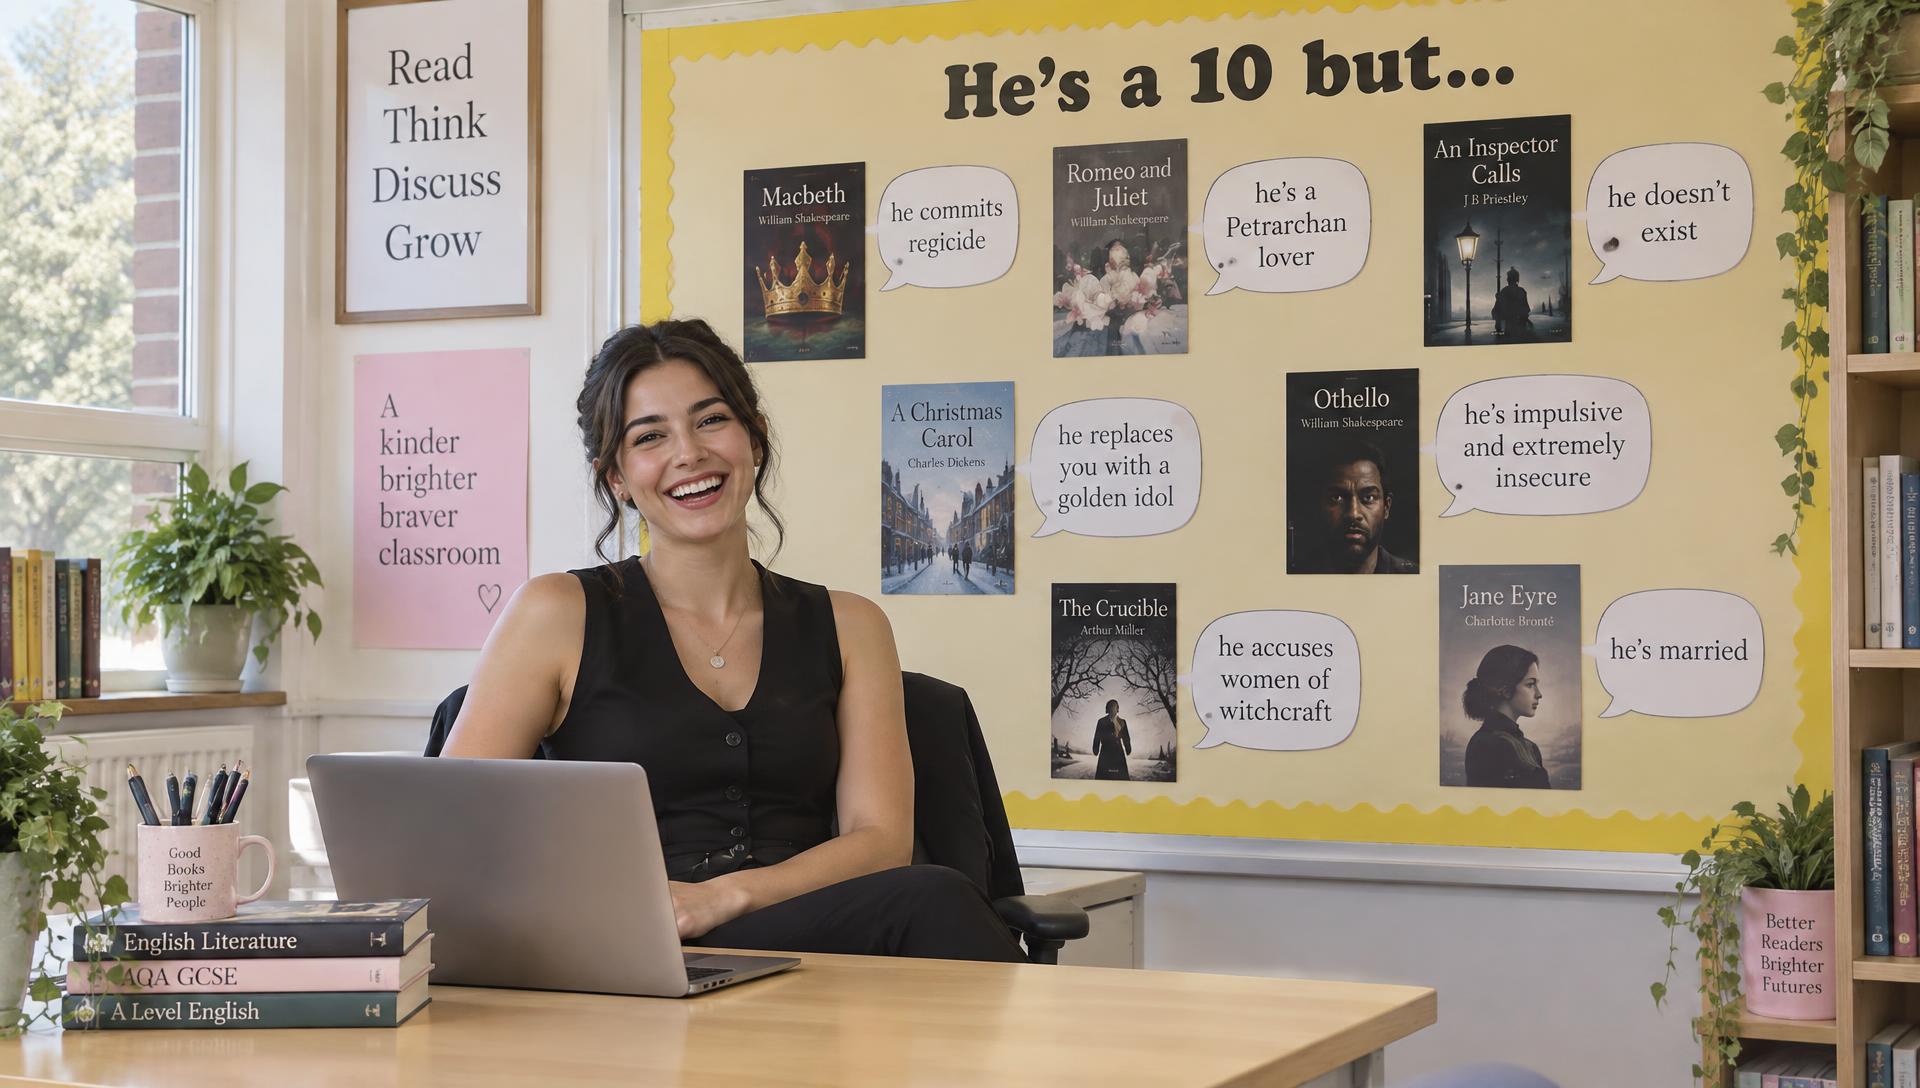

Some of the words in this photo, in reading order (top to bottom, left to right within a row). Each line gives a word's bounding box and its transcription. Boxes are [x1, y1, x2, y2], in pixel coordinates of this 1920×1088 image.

[389, 42, 473, 85] Read
[944, 56, 1090, 119] He's
[1121, 66, 1161, 108] a
[1191, 44, 1272, 103] 10
[1302, 36, 1514, 97] but...
[384, 101, 487, 143] Think
[1434, 140, 1461, 158] An
[1469, 138, 1558, 161] Inspector
[1068, 164, 1134, 183] Romeo
[1140, 157, 1171, 178] and
[1472, 160, 1520, 184] Calls
[373, 166, 500, 202] Discuss
[763, 183, 845, 206] Macbeth
[1256, 182, 1295, 203] he's
[1305, 186, 1316, 200] a
[1608, 185, 1635, 207] he
[1645, 180, 1730, 205] doesn't
[892, 202, 913, 221] he
[921, 199, 1002, 220] commits
[1092, 186, 1147, 212] Juliet
[1464, 195, 1468, 207] J
[1472, 195, 1479, 205] B
[1483, 193, 1528, 205] Priestley
[759, 216, 792, 224] William
[795, 213, 850, 224] Shakespeare
[1227, 212, 1347, 237] Petrarchan
[386, 225, 482, 260] Grow
[1642, 220, 1697, 242] exist
[909, 229, 985, 258] regicide
[1259, 246, 1314, 267] lover
[381, 394, 398, 418] A
[1315, 387, 1389, 409] Othello
[892, 403, 905, 422] A
[911, 402, 1002, 421] Christmas
[1301, 418, 1338, 428] William
[1343, 416, 1403, 430] Shakespeare
[1465, 403, 1504, 424] he's
[1514, 400, 1622, 429] impulsive
[381, 427, 459, 455] kinder
[922, 427, 972, 447] Carol
[1059, 424, 1082, 444] he
[1091, 423, 1172, 449] replaces
[1464, 434, 1504, 456] and
[1513, 432, 1625, 460] extremely
[908, 458, 944, 468] Charles
[948, 457, 985, 467] Dickens
[1060, 463, 1096, 483] you
[1105, 454, 1151, 475] with
[1160, 461, 1170, 474] a
[380, 464, 477, 498] brighter
[1496, 468, 1590, 487] insecure
[1058, 486, 1126, 514] golden
[1135, 485, 1173, 506] idol
[380, 502, 458, 528] braver
[379, 538, 500, 565] classroom
[1059, 599, 1091, 616] The
[1096, 598, 1167, 616] Crucible
[1460, 585, 1503, 608] Jane
[1512, 585, 1556, 610] Eyre
[1080, 625, 1112, 636] Arthur
[1465, 616, 1515, 626] Charlotte
[1219, 635, 1243, 656] he
[1252, 643, 1333, 657] accuses
[1611, 637, 1651, 659] he's
[1660, 639, 1748, 660] married
[1221, 675, 1300, 688] women
[1309, 668, 1331, 689] of
[1220, 699, 1332, 721] witchcraft
[169, 847, 200, 858] Good
[168, 863, 204, 875] Books
[165, 880, 213, 894] Brighter
[1767, 913, 1815, 930] Better
[125, 932, 195, 955] English
[202, 932, 297, 949] Literature
[1762, 934, 1822, 951] Readers
[1761, 955, 1825, 975] Brighter
[121, 967, 170, 988] AQA
[178, 967, 237, 985] GCSE
[1763, 976, 1823, 994] Futures
[112, 1002, 126, 1020] A
[132, 1002, 182, 1020] Level
[189, 1001, 259, 1025] English
